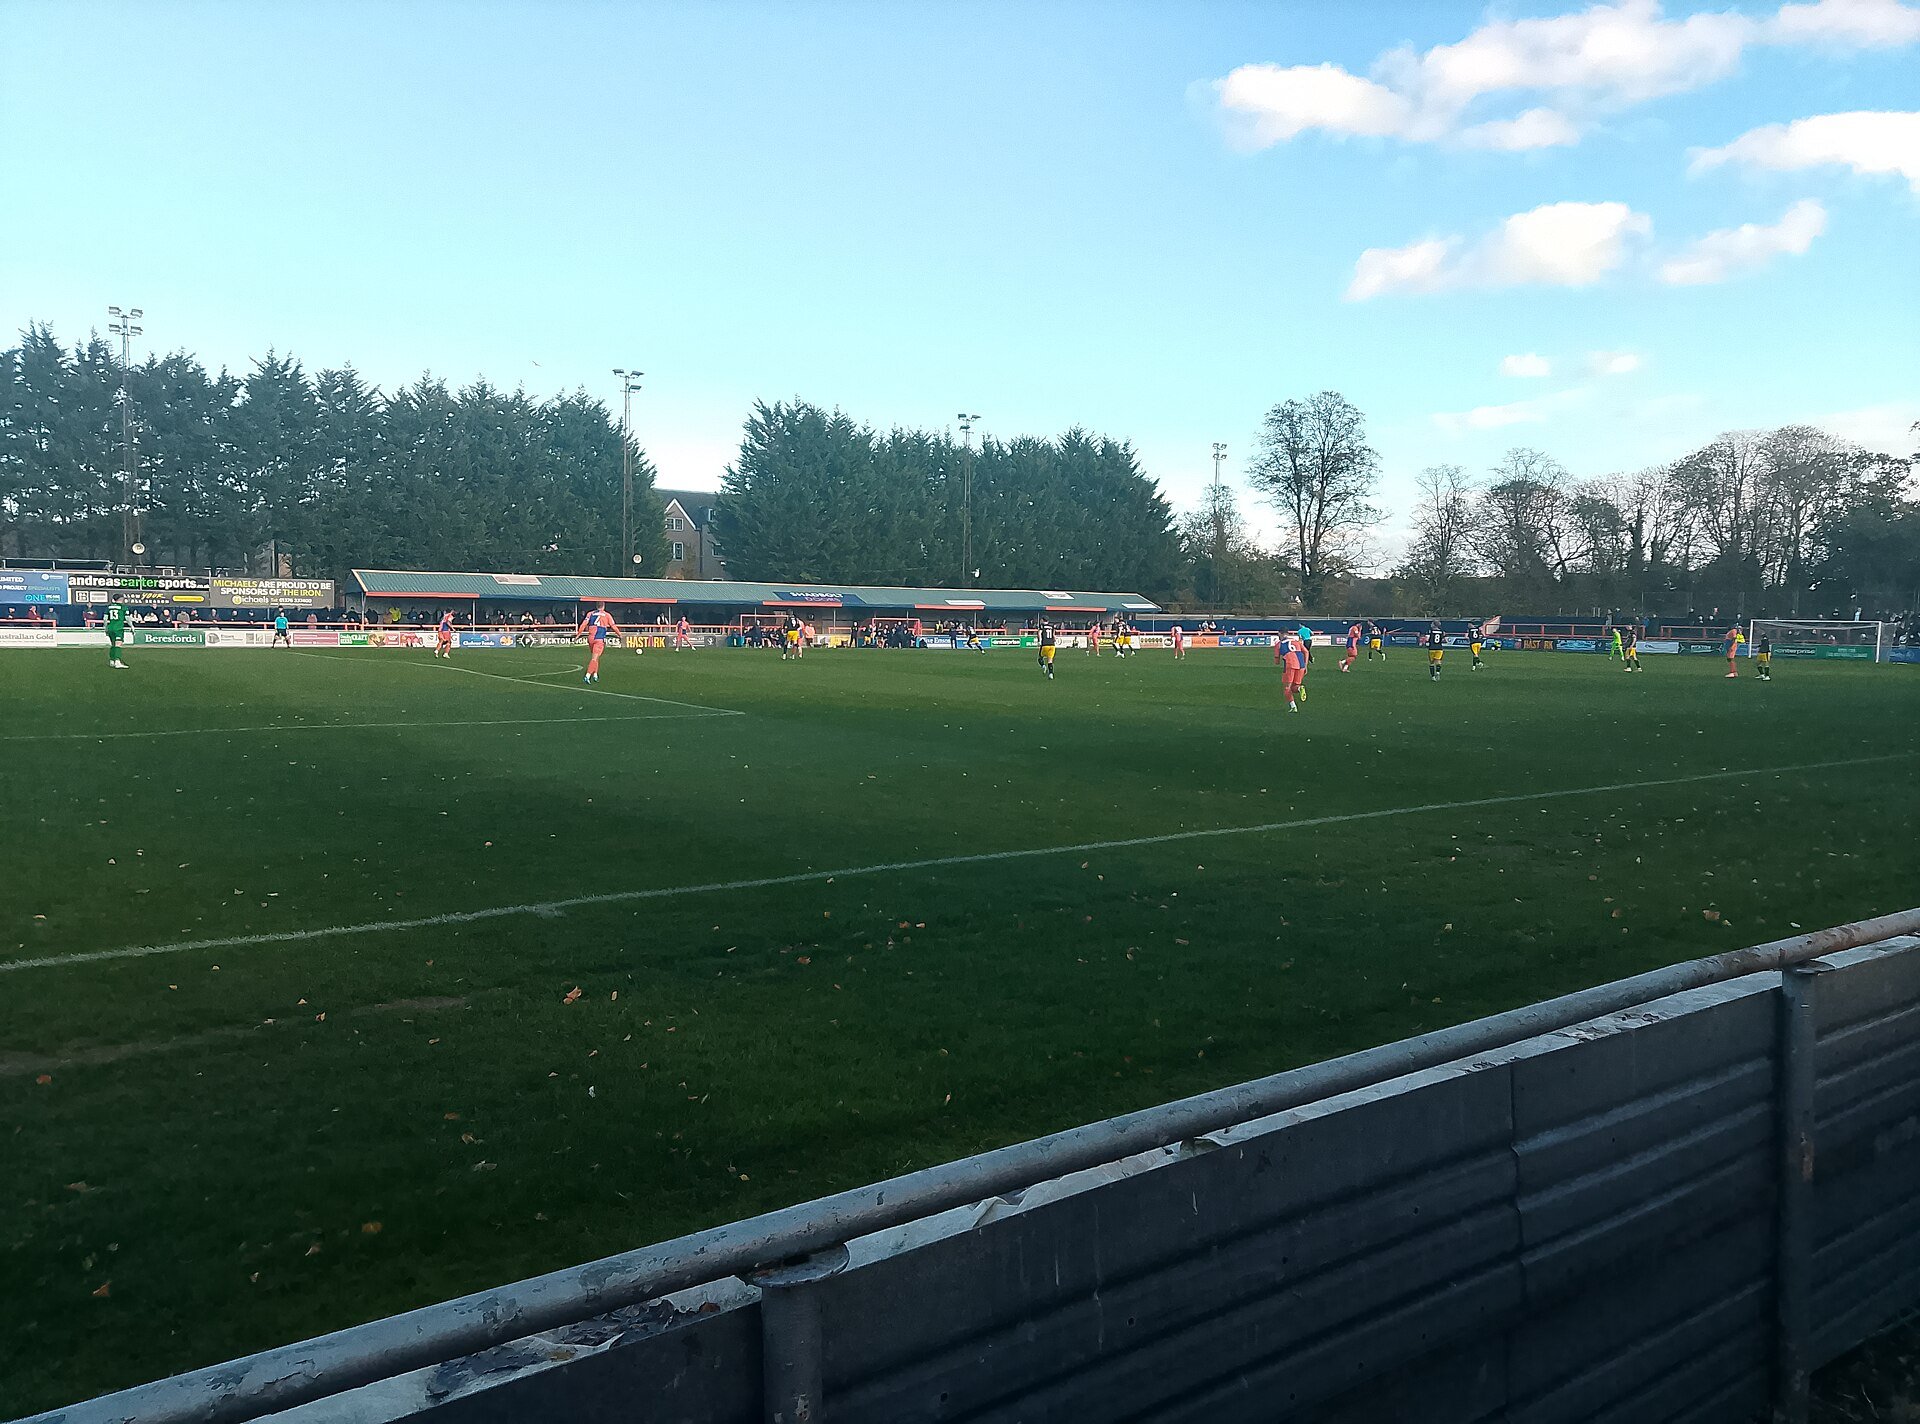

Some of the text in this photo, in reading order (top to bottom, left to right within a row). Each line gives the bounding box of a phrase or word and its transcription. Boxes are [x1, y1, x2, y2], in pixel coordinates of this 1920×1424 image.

[213, 580, 332, 590] MICHAELS ARE PROUD TO BE
[220, 587, 268, 596] SPONSORS
[269, 587, 281, 595] OF
[282, 588, 299, 596] THE
[109, 610, 119, 620] 13
[145, 634, 197, 643] Beresfords
[1434, 634, 1440, 643] 8
[1472, 630, 1478, 638] 6
[1288, 640, 1296, 652] 6
